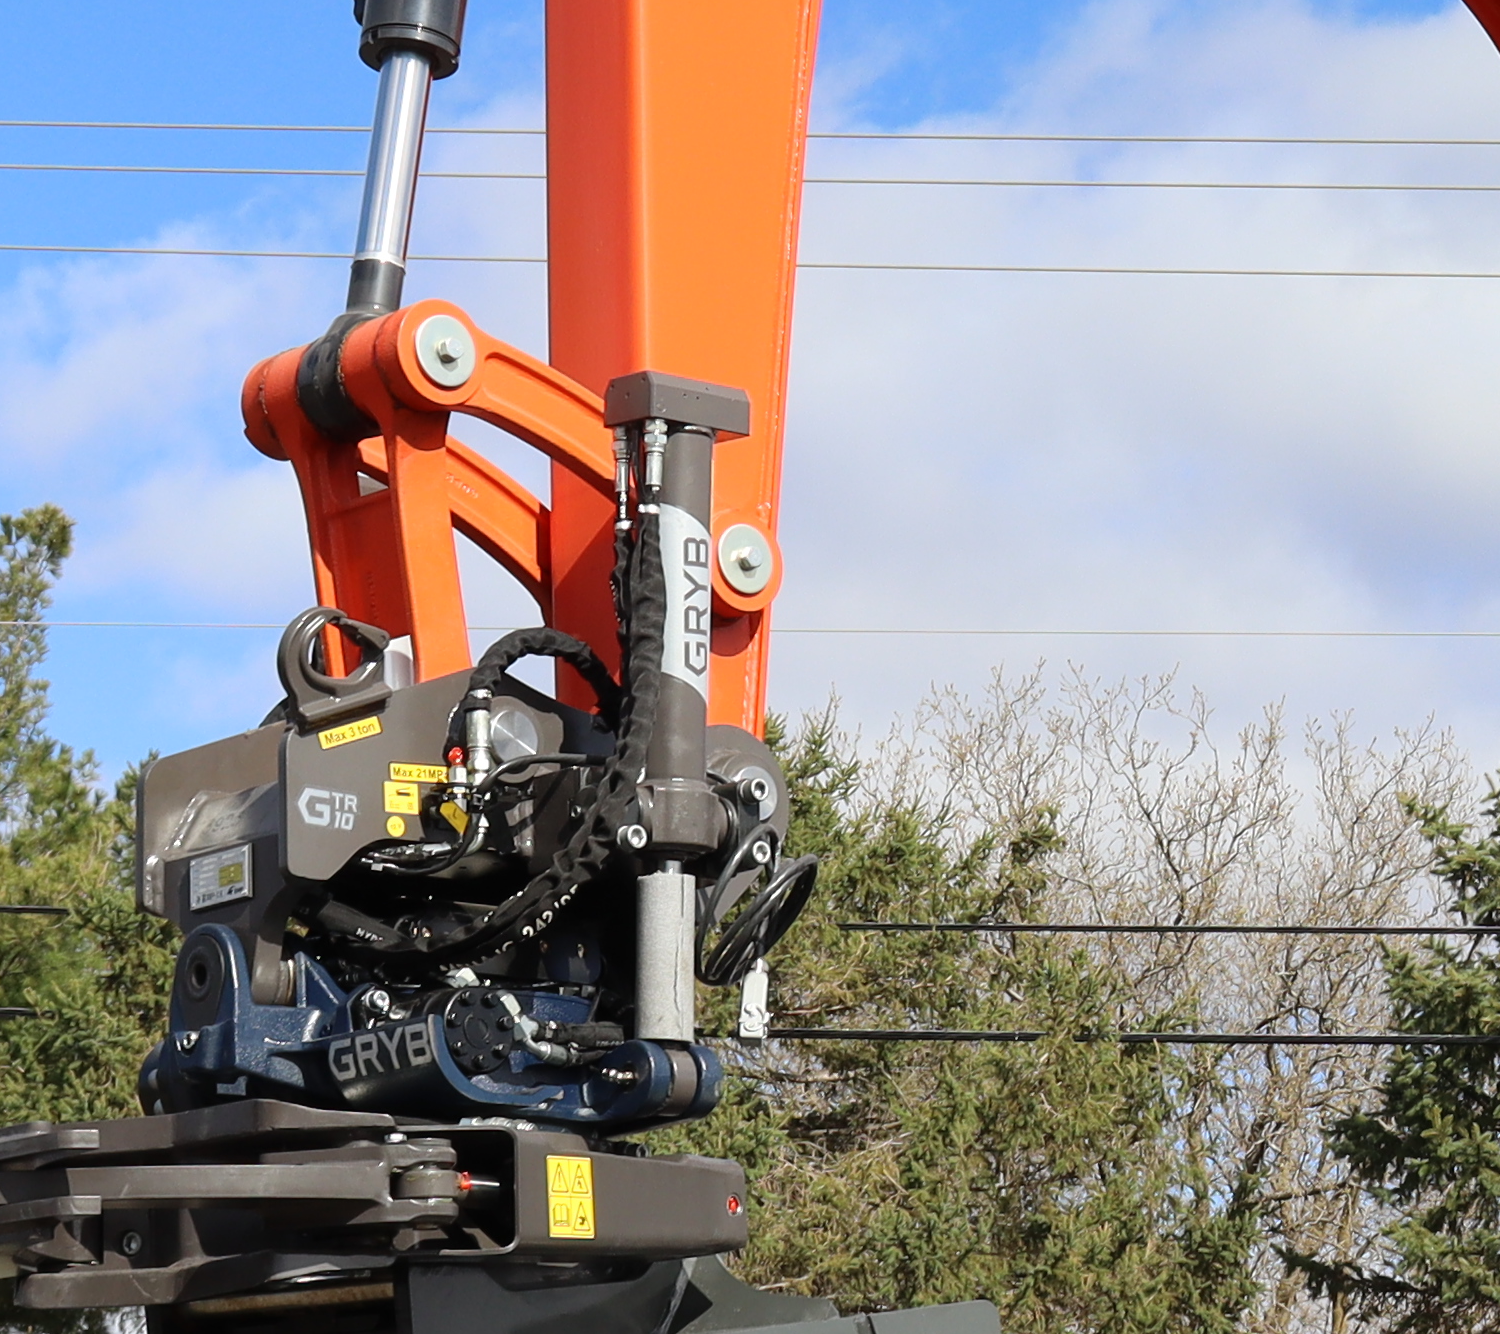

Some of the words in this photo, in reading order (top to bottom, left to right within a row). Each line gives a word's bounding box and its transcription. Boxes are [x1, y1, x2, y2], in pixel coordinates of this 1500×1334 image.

[682, 537, 709, 677] GRYB
[324, 731, 347, 745] Max
[348, 727, 356, 738] 3
[357, 723, 376, 735] ton
[393, 766, 414, 778] Max
[415, 768, 448, 780] 21MP
[331, 791, 358, 813] TR
[334, 810, 355, 831] 10
[328, 1021, 435, 1082] GRYB
